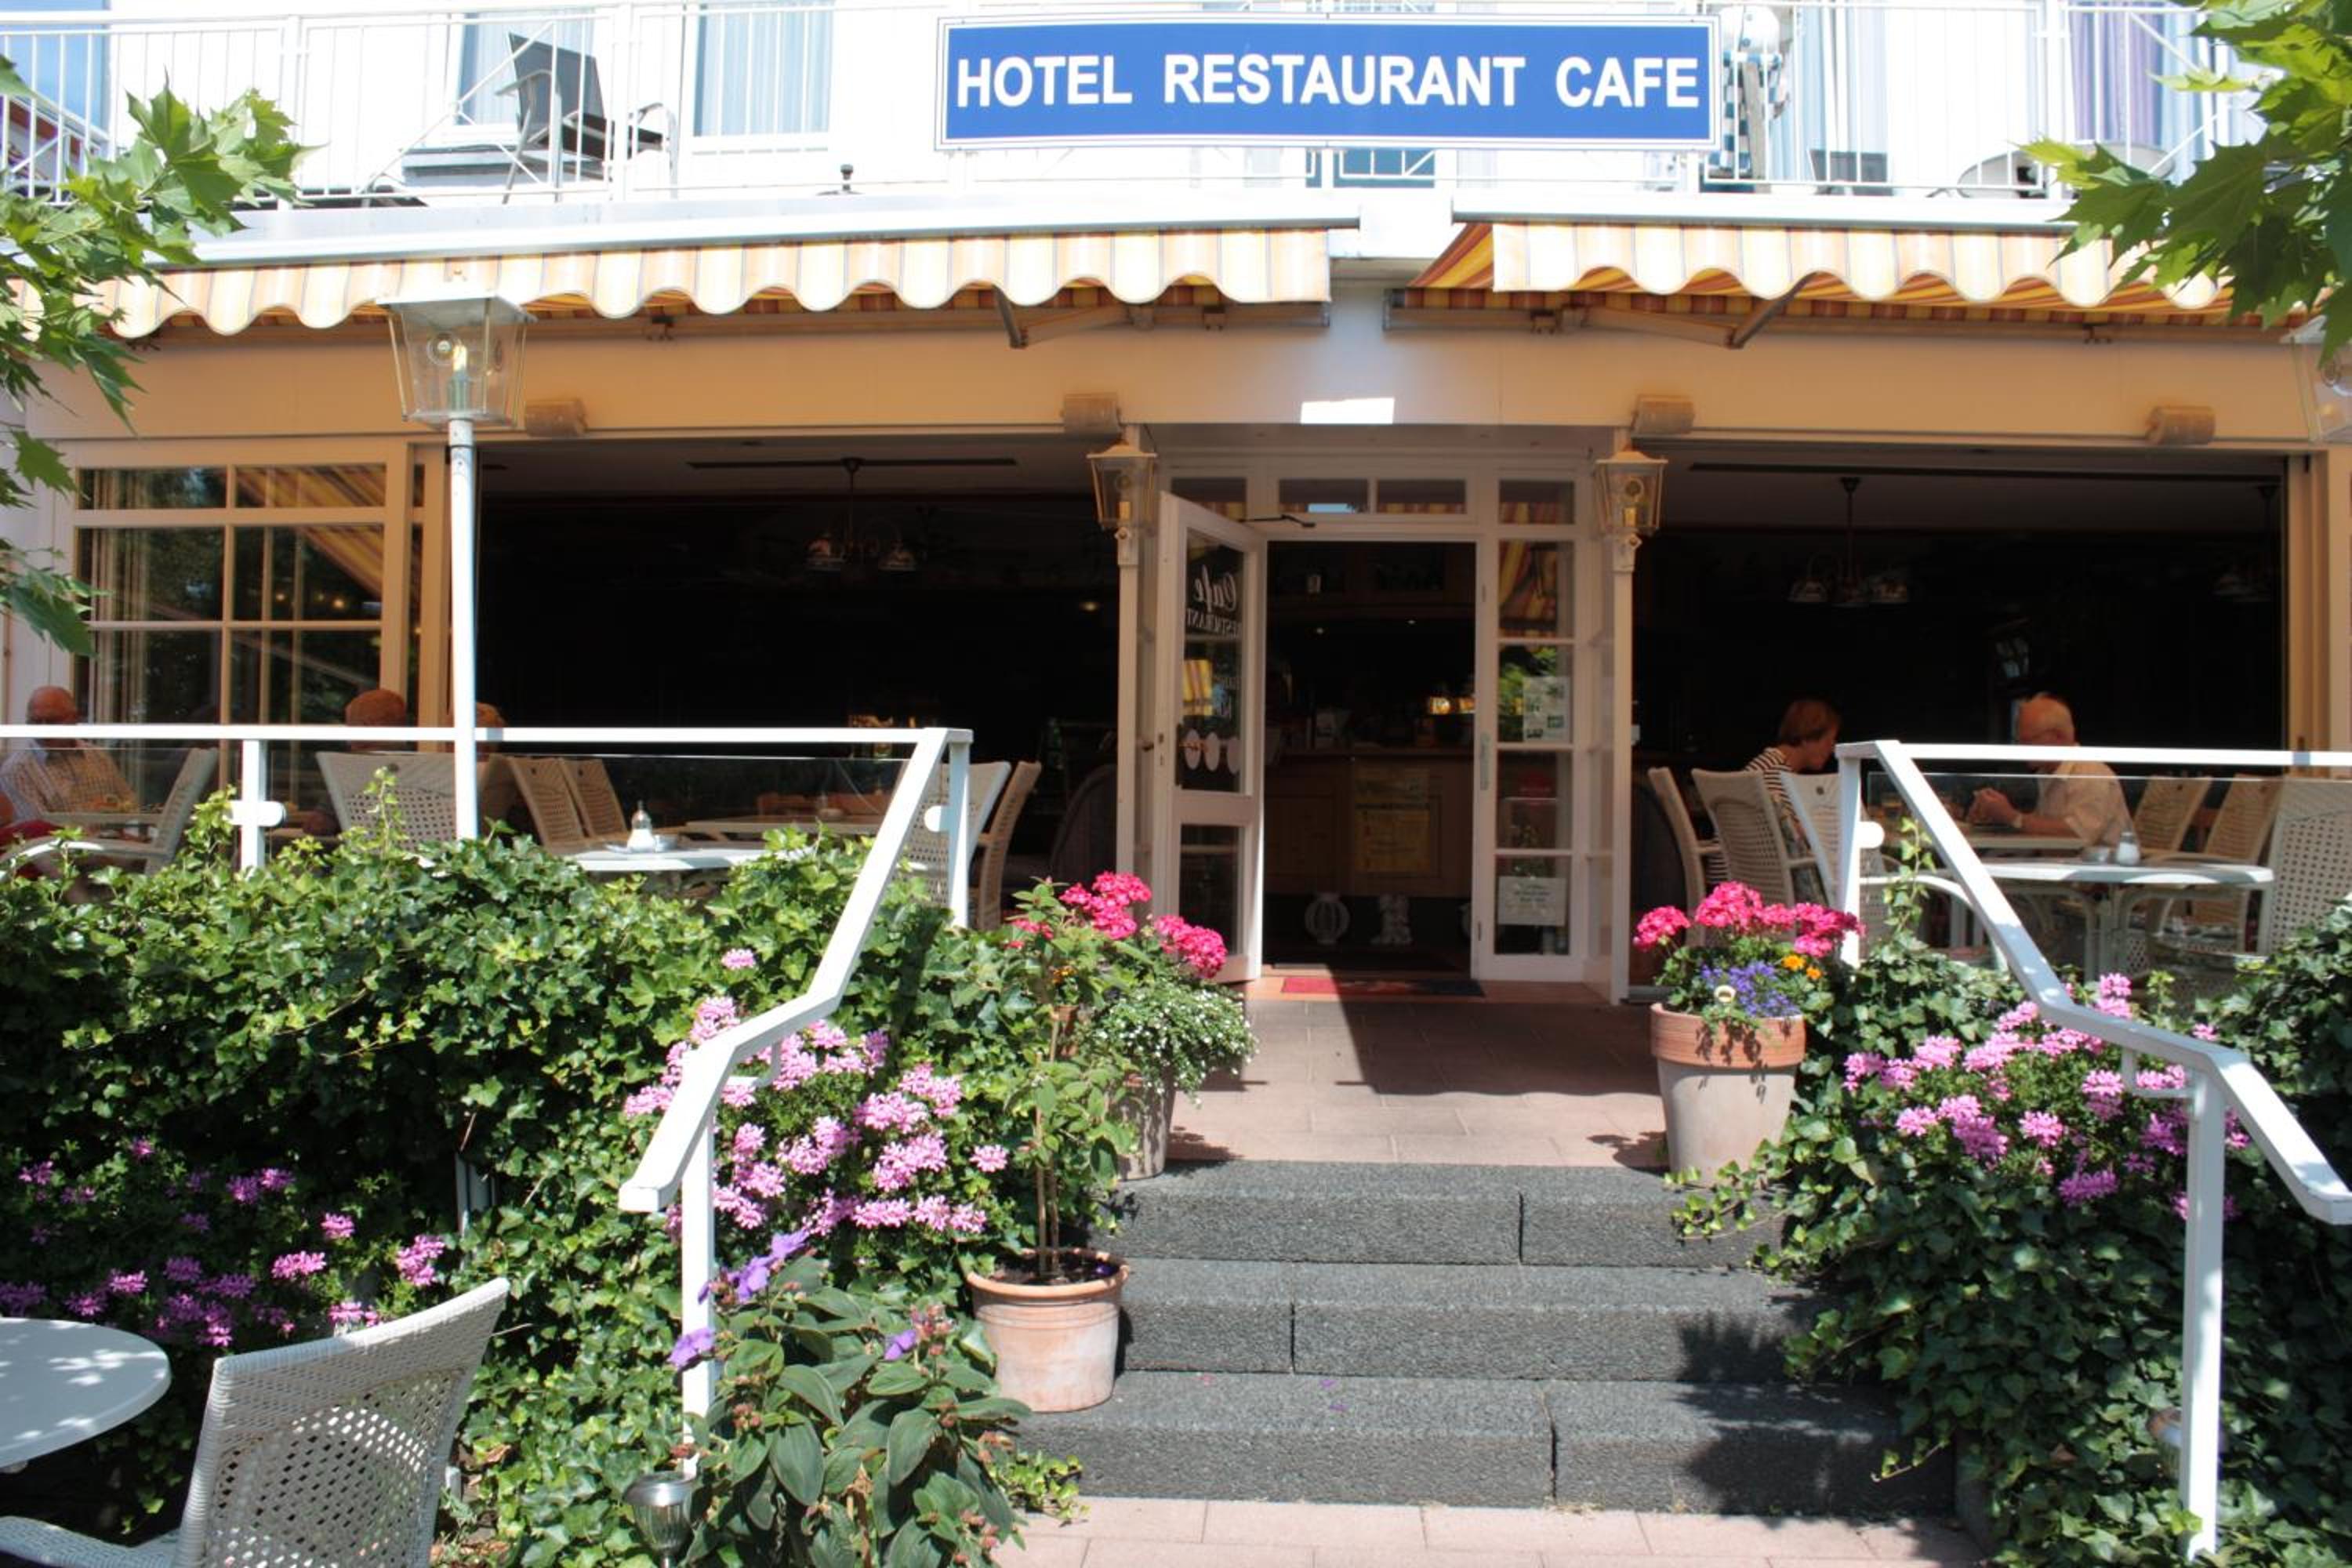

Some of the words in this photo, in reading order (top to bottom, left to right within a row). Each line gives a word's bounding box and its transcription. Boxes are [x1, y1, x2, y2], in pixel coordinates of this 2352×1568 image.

[957, 55, 1132, 107] HOTEL
[1164, 53, 1526, 107] RESTAURANT
[1556, 56, 1699, 107] CAFE
